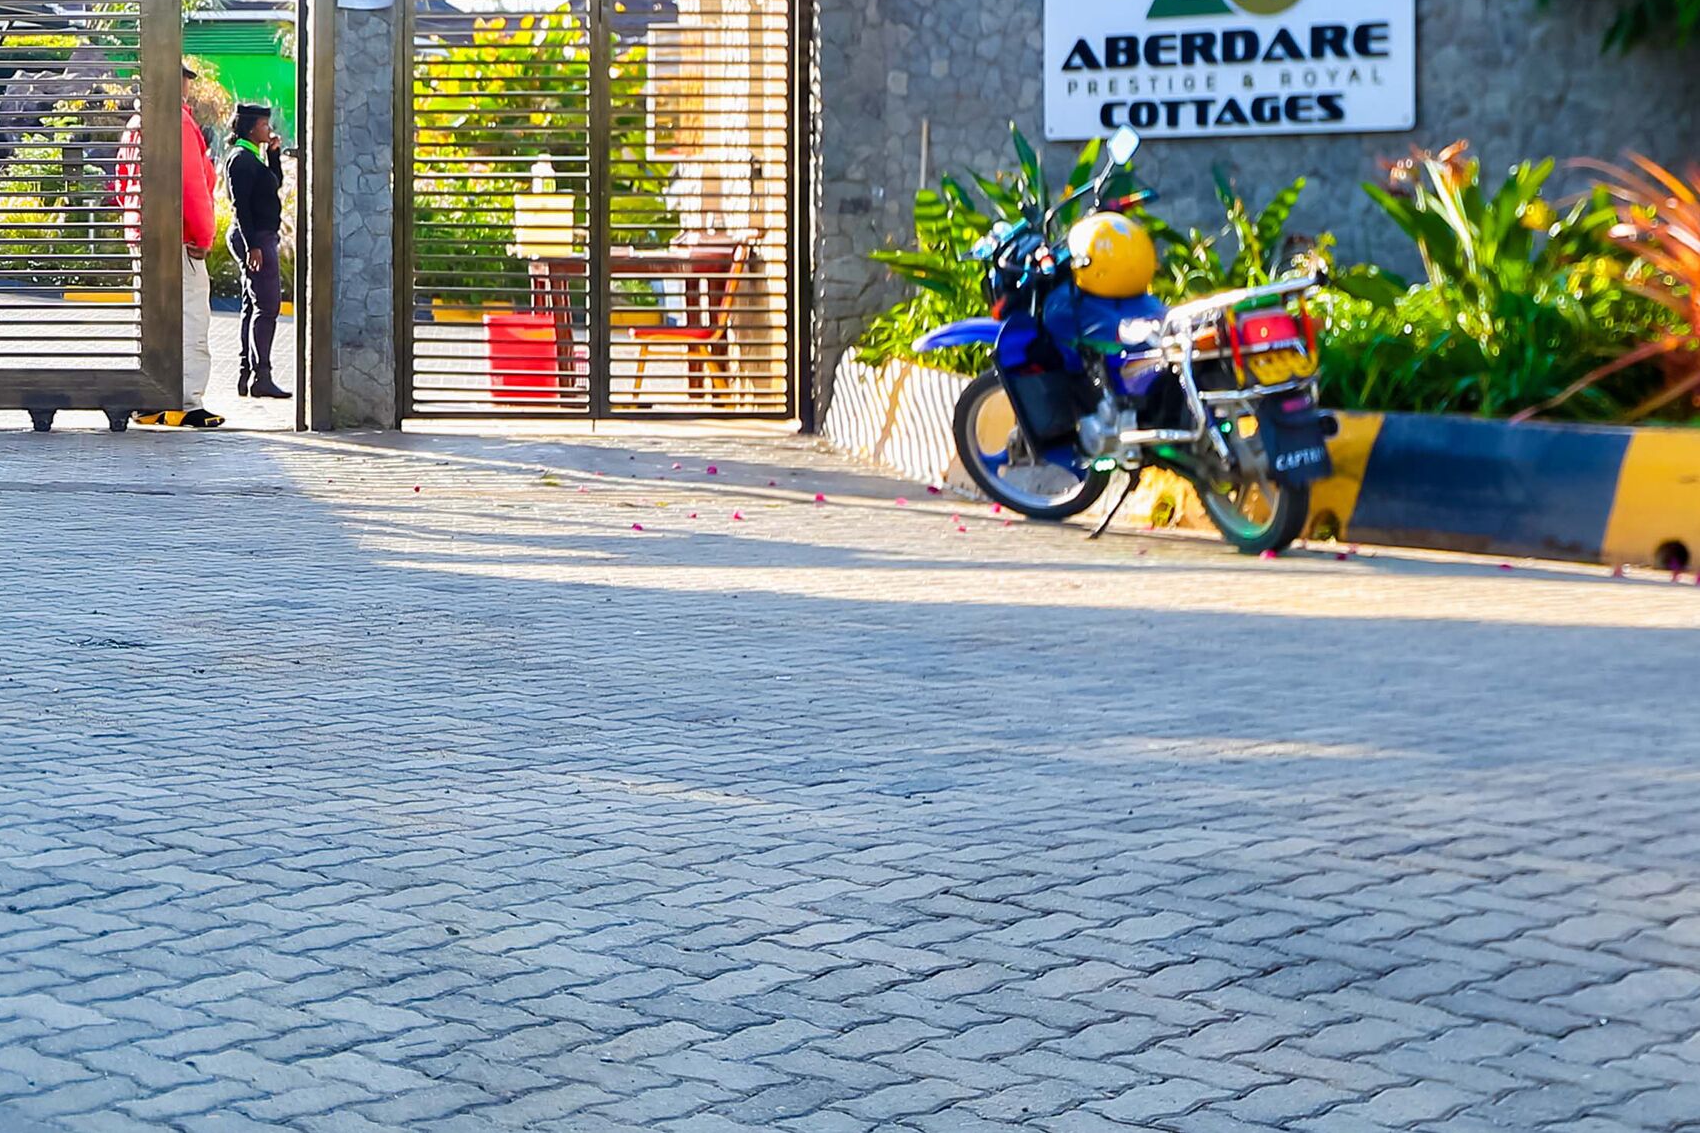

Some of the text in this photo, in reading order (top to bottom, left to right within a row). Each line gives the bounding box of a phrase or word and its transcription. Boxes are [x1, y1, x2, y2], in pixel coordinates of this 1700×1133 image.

[1061, 22, 1390, 72] ABERDARE
[1067, 66, 1383, 97] PRESTIGE & ROYAL
[1100, 94, 1345, 129] COTTAGES
